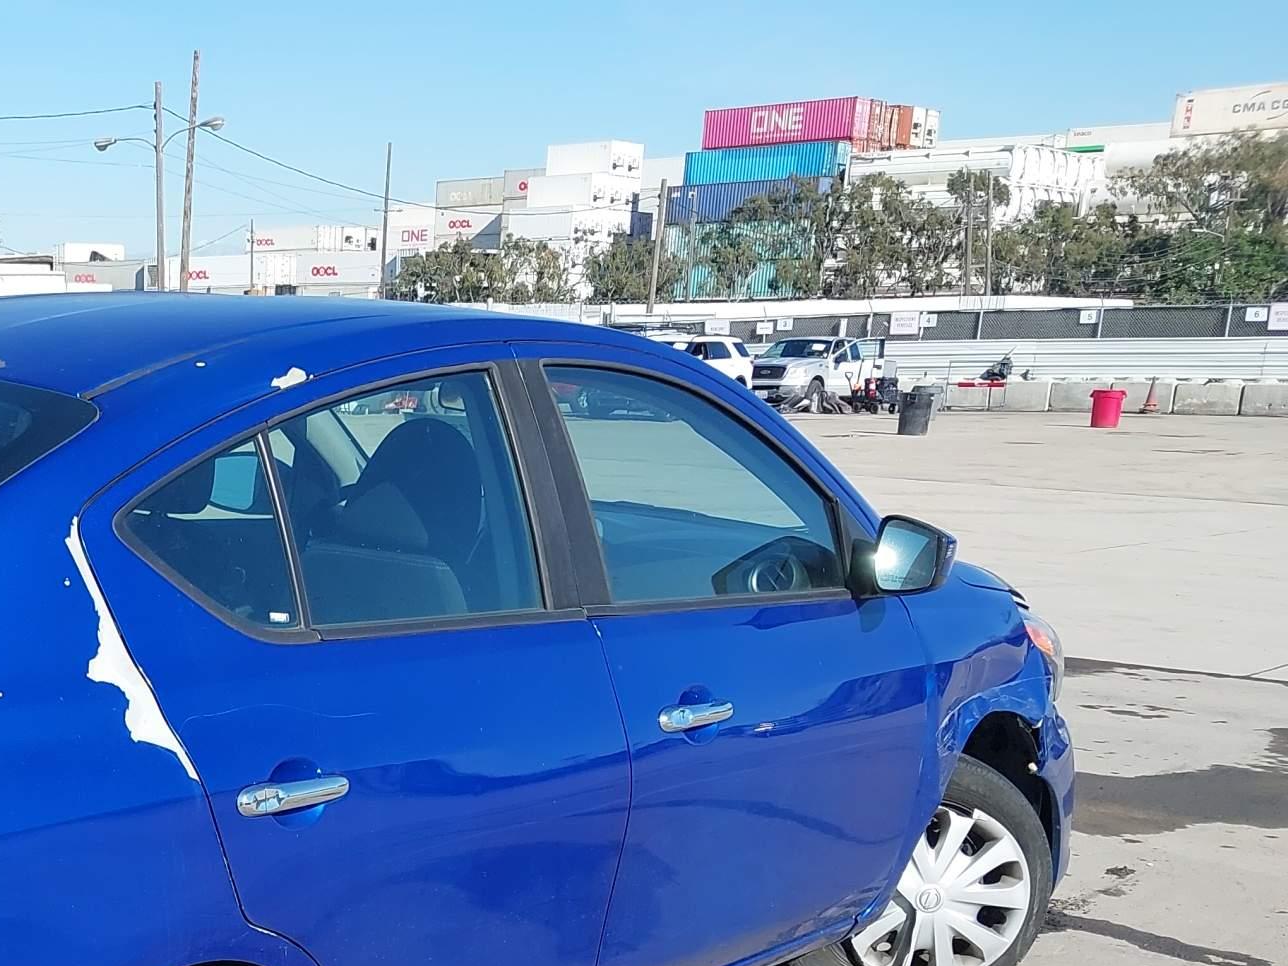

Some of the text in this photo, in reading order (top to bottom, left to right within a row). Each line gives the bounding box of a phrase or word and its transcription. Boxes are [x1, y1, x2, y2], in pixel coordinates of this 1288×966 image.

[1232, 99, 1288, 114] CMA CG
[750, 107, 803, 133] ONE
[448, 219, 472, 229] OOCL
[401, 229, 428, 242] ONE
[256, 238, 275, 246] OOCL
[312, 266, 338, 277] OOCL
[74, 274, 97, 284] OOCL
[925, 316, 931, 324] 4
[1087, 313, 1093, 321] 5
